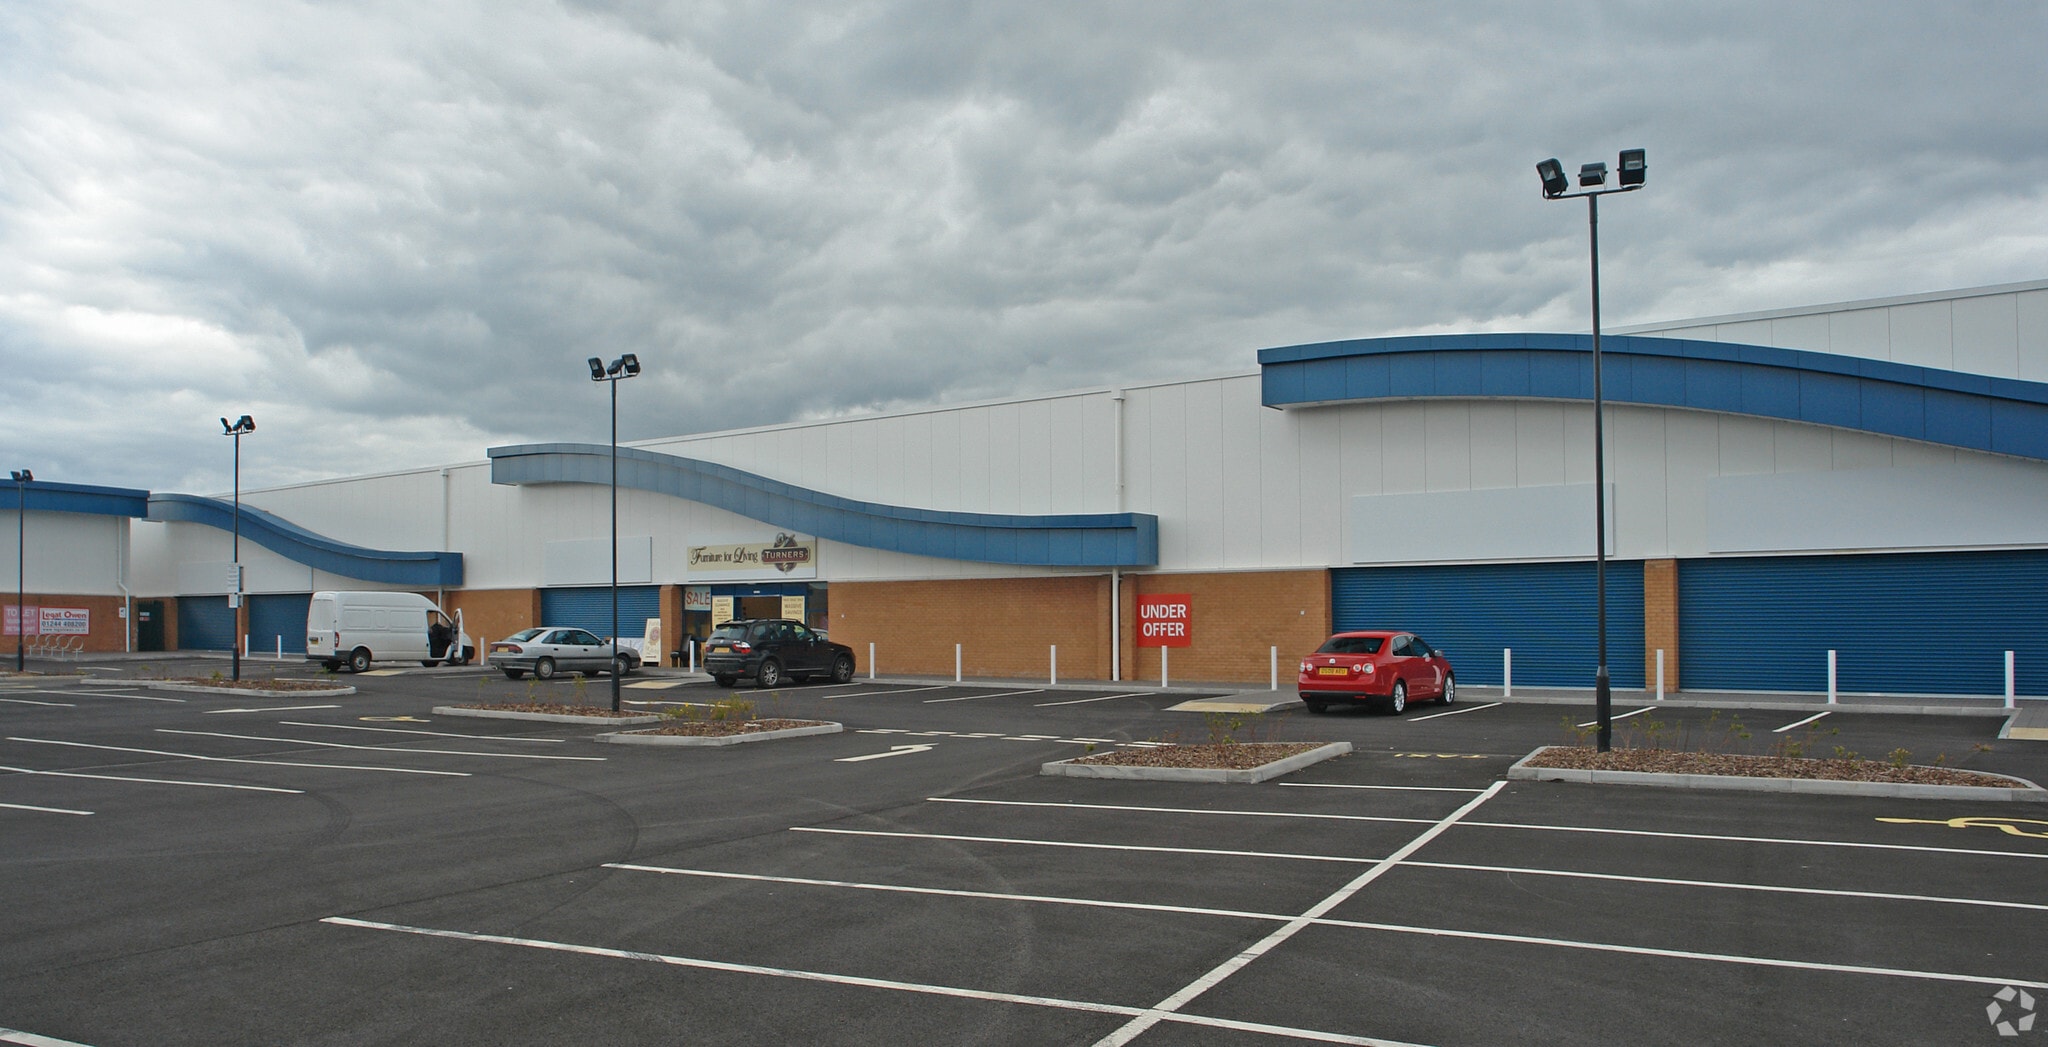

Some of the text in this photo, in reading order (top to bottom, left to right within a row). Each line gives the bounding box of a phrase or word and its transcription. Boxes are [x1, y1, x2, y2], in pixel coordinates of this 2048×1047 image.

[690, 546, 758, 565] Furniture for Living
[764, 550, 804, 560] TURNERS
[686, 591, 710, 605] SALE
[6, 608, 17, 616] TO
[64, 611, 87, 619] Owen
[1141, 604, 1187, 619] UNDER
[1143, 622, 1185, 637] OFFER
